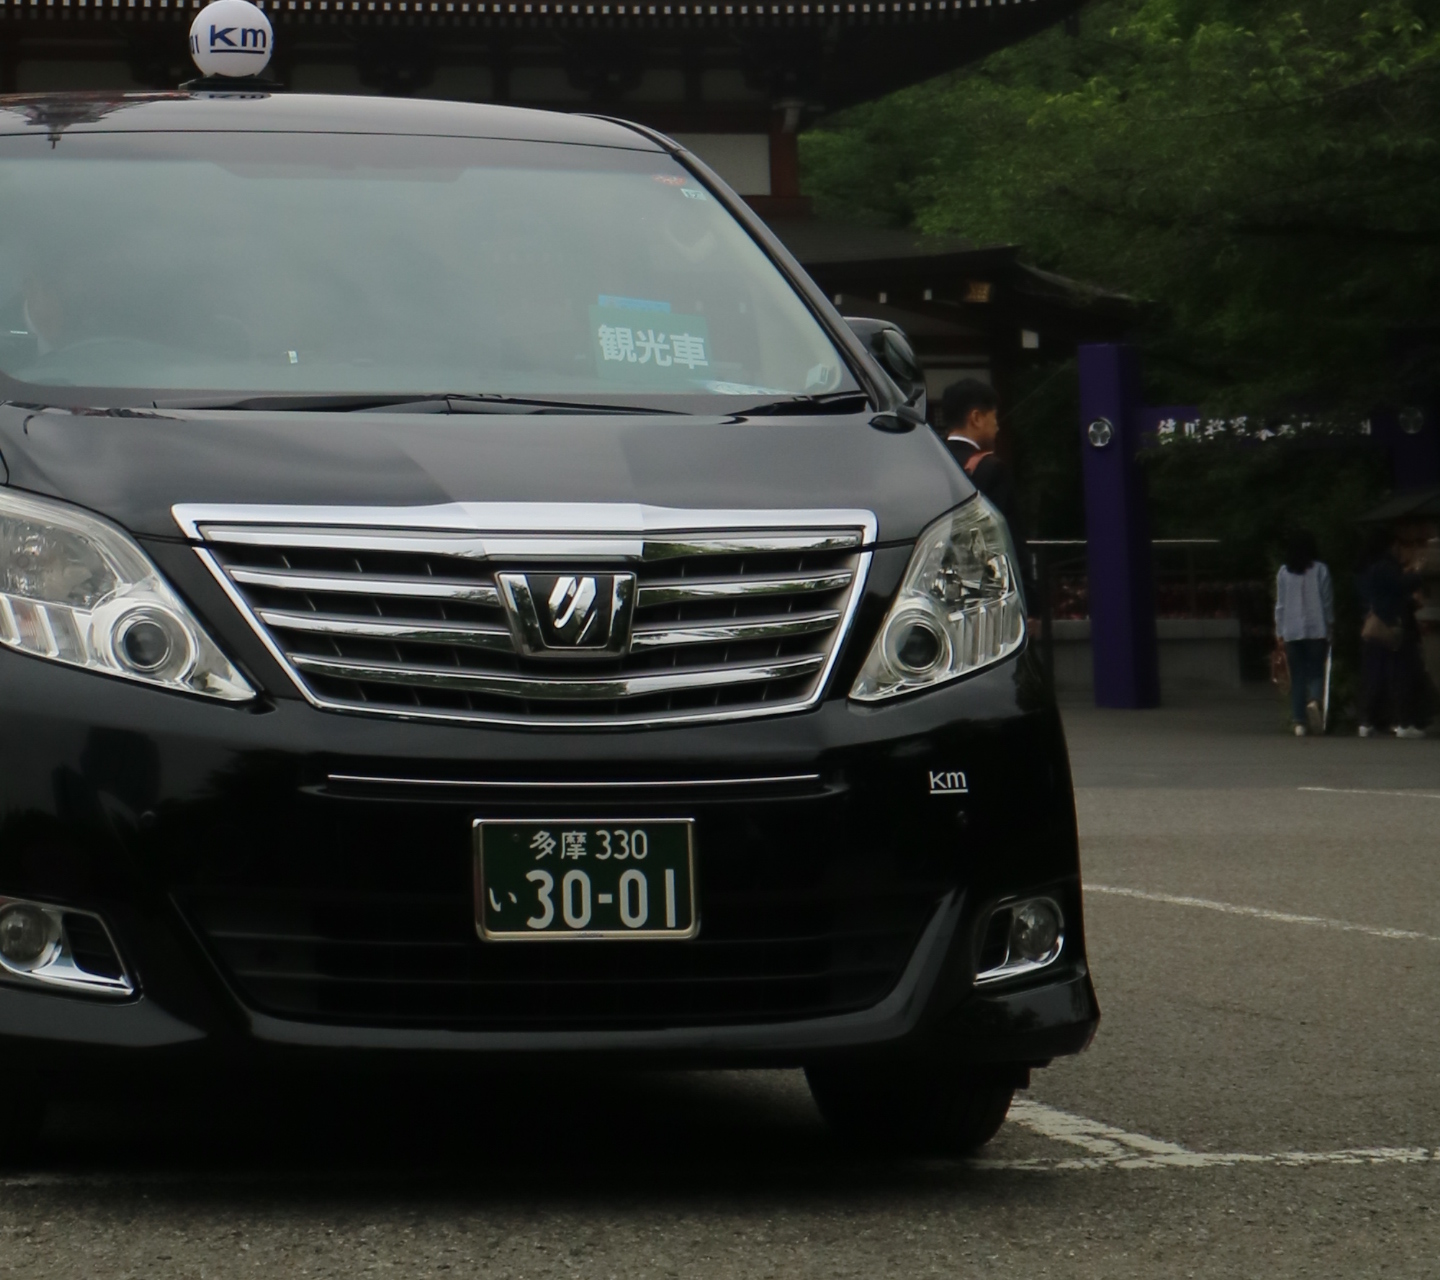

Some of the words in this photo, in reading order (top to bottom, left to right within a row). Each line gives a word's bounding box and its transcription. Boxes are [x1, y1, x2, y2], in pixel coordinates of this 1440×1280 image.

[598, 323, 709, 370] 観光車
[529, 830, 588, 860] 多摩
[595, 829, 648, 860] 330
[489, 887, 518, 913] い
[525, 868, 676, 929] 30-01
